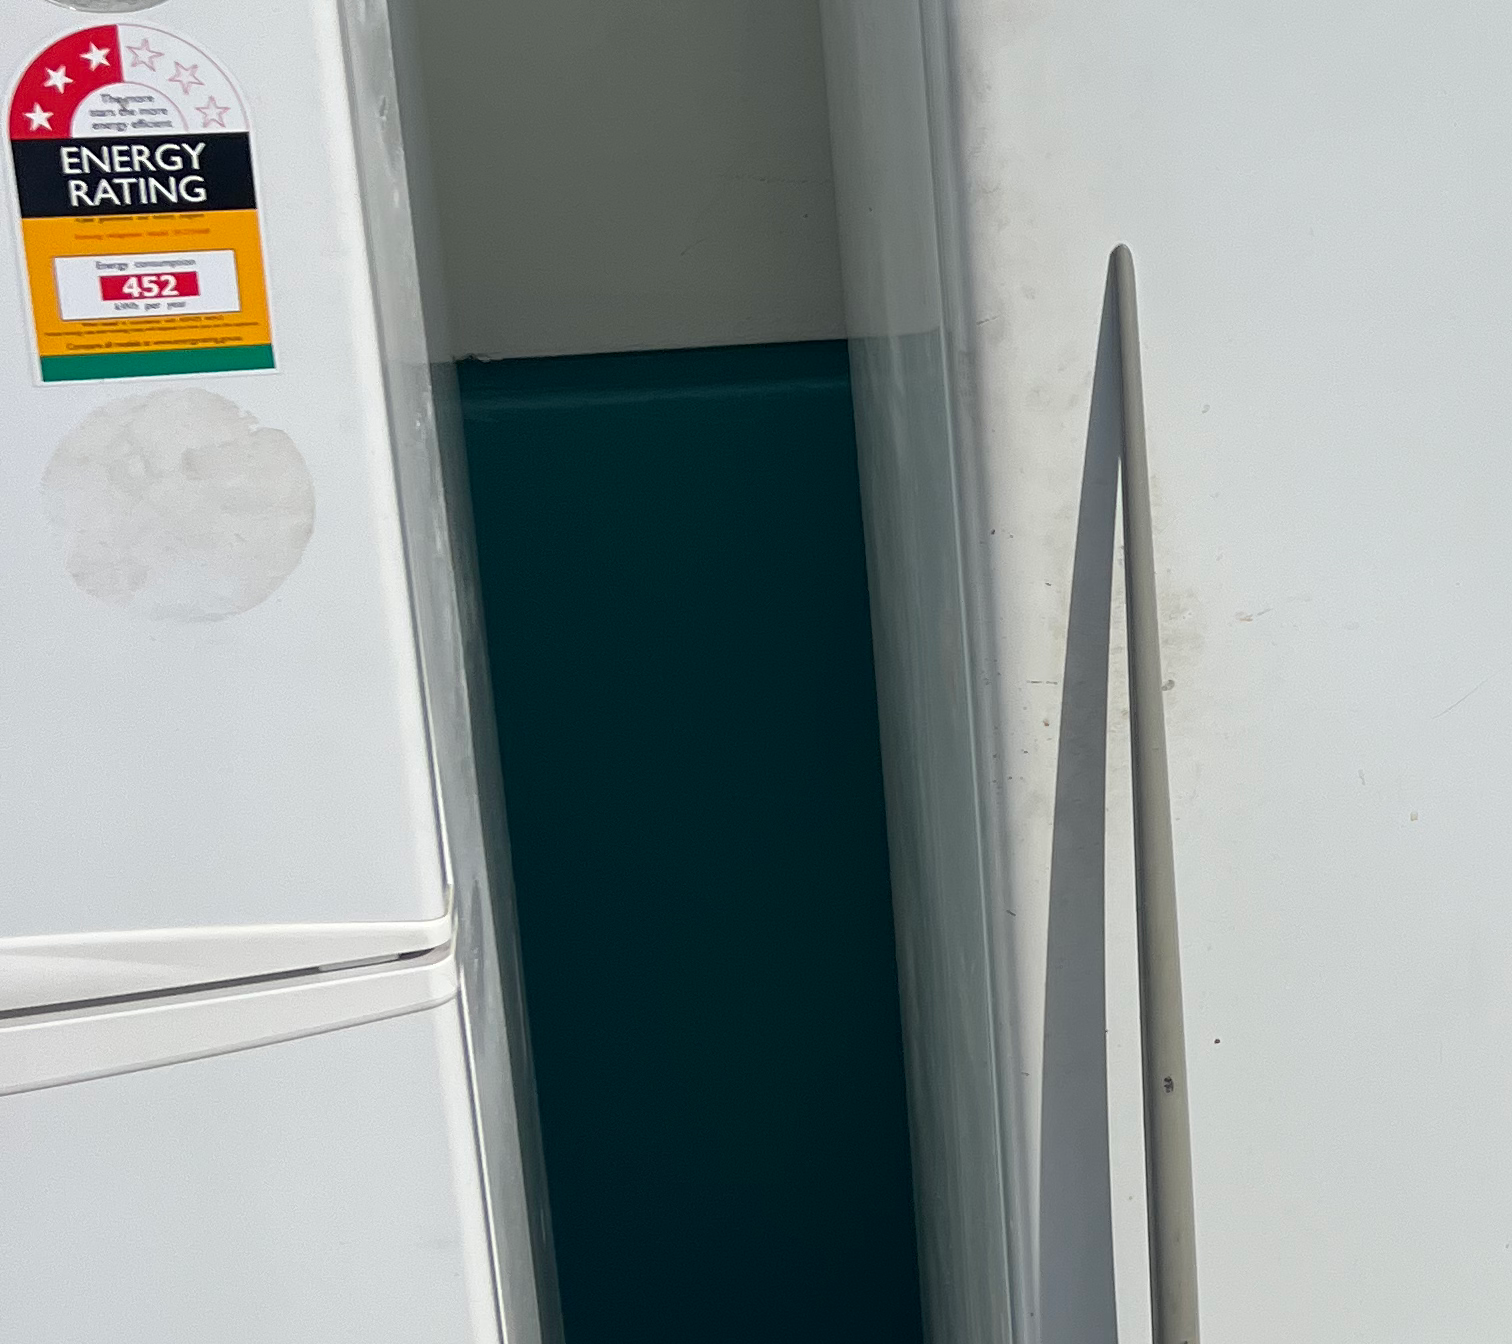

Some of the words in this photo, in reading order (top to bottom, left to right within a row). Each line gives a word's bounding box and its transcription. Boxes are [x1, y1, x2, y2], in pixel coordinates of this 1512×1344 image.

[60, 142, 206, 175] ENERGY
[67, 175, 207, 207] RATING
[122, 274, 179, 298] 452
